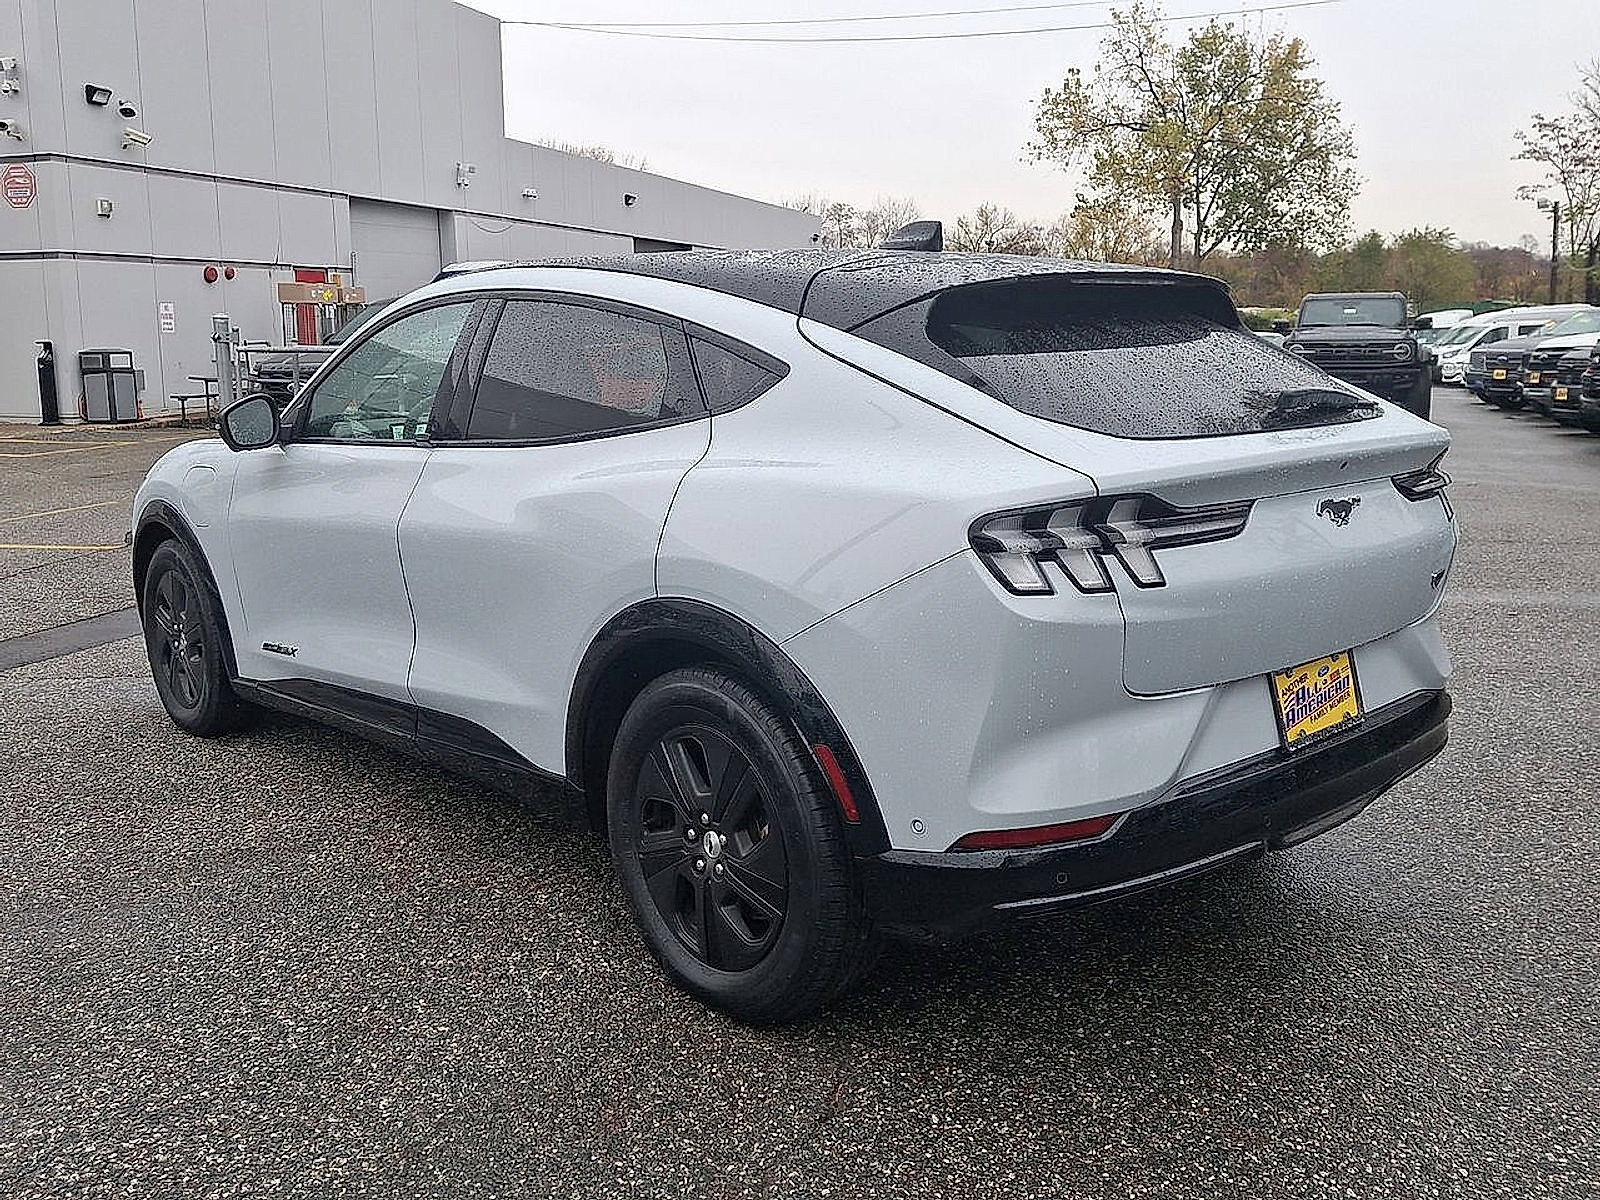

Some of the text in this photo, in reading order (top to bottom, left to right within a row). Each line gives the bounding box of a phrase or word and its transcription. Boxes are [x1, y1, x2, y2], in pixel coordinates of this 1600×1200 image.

[1281, 672, 1309, 698] ANOTHER
[1309, 690, 1352, 724] FAMILY MEMBER
